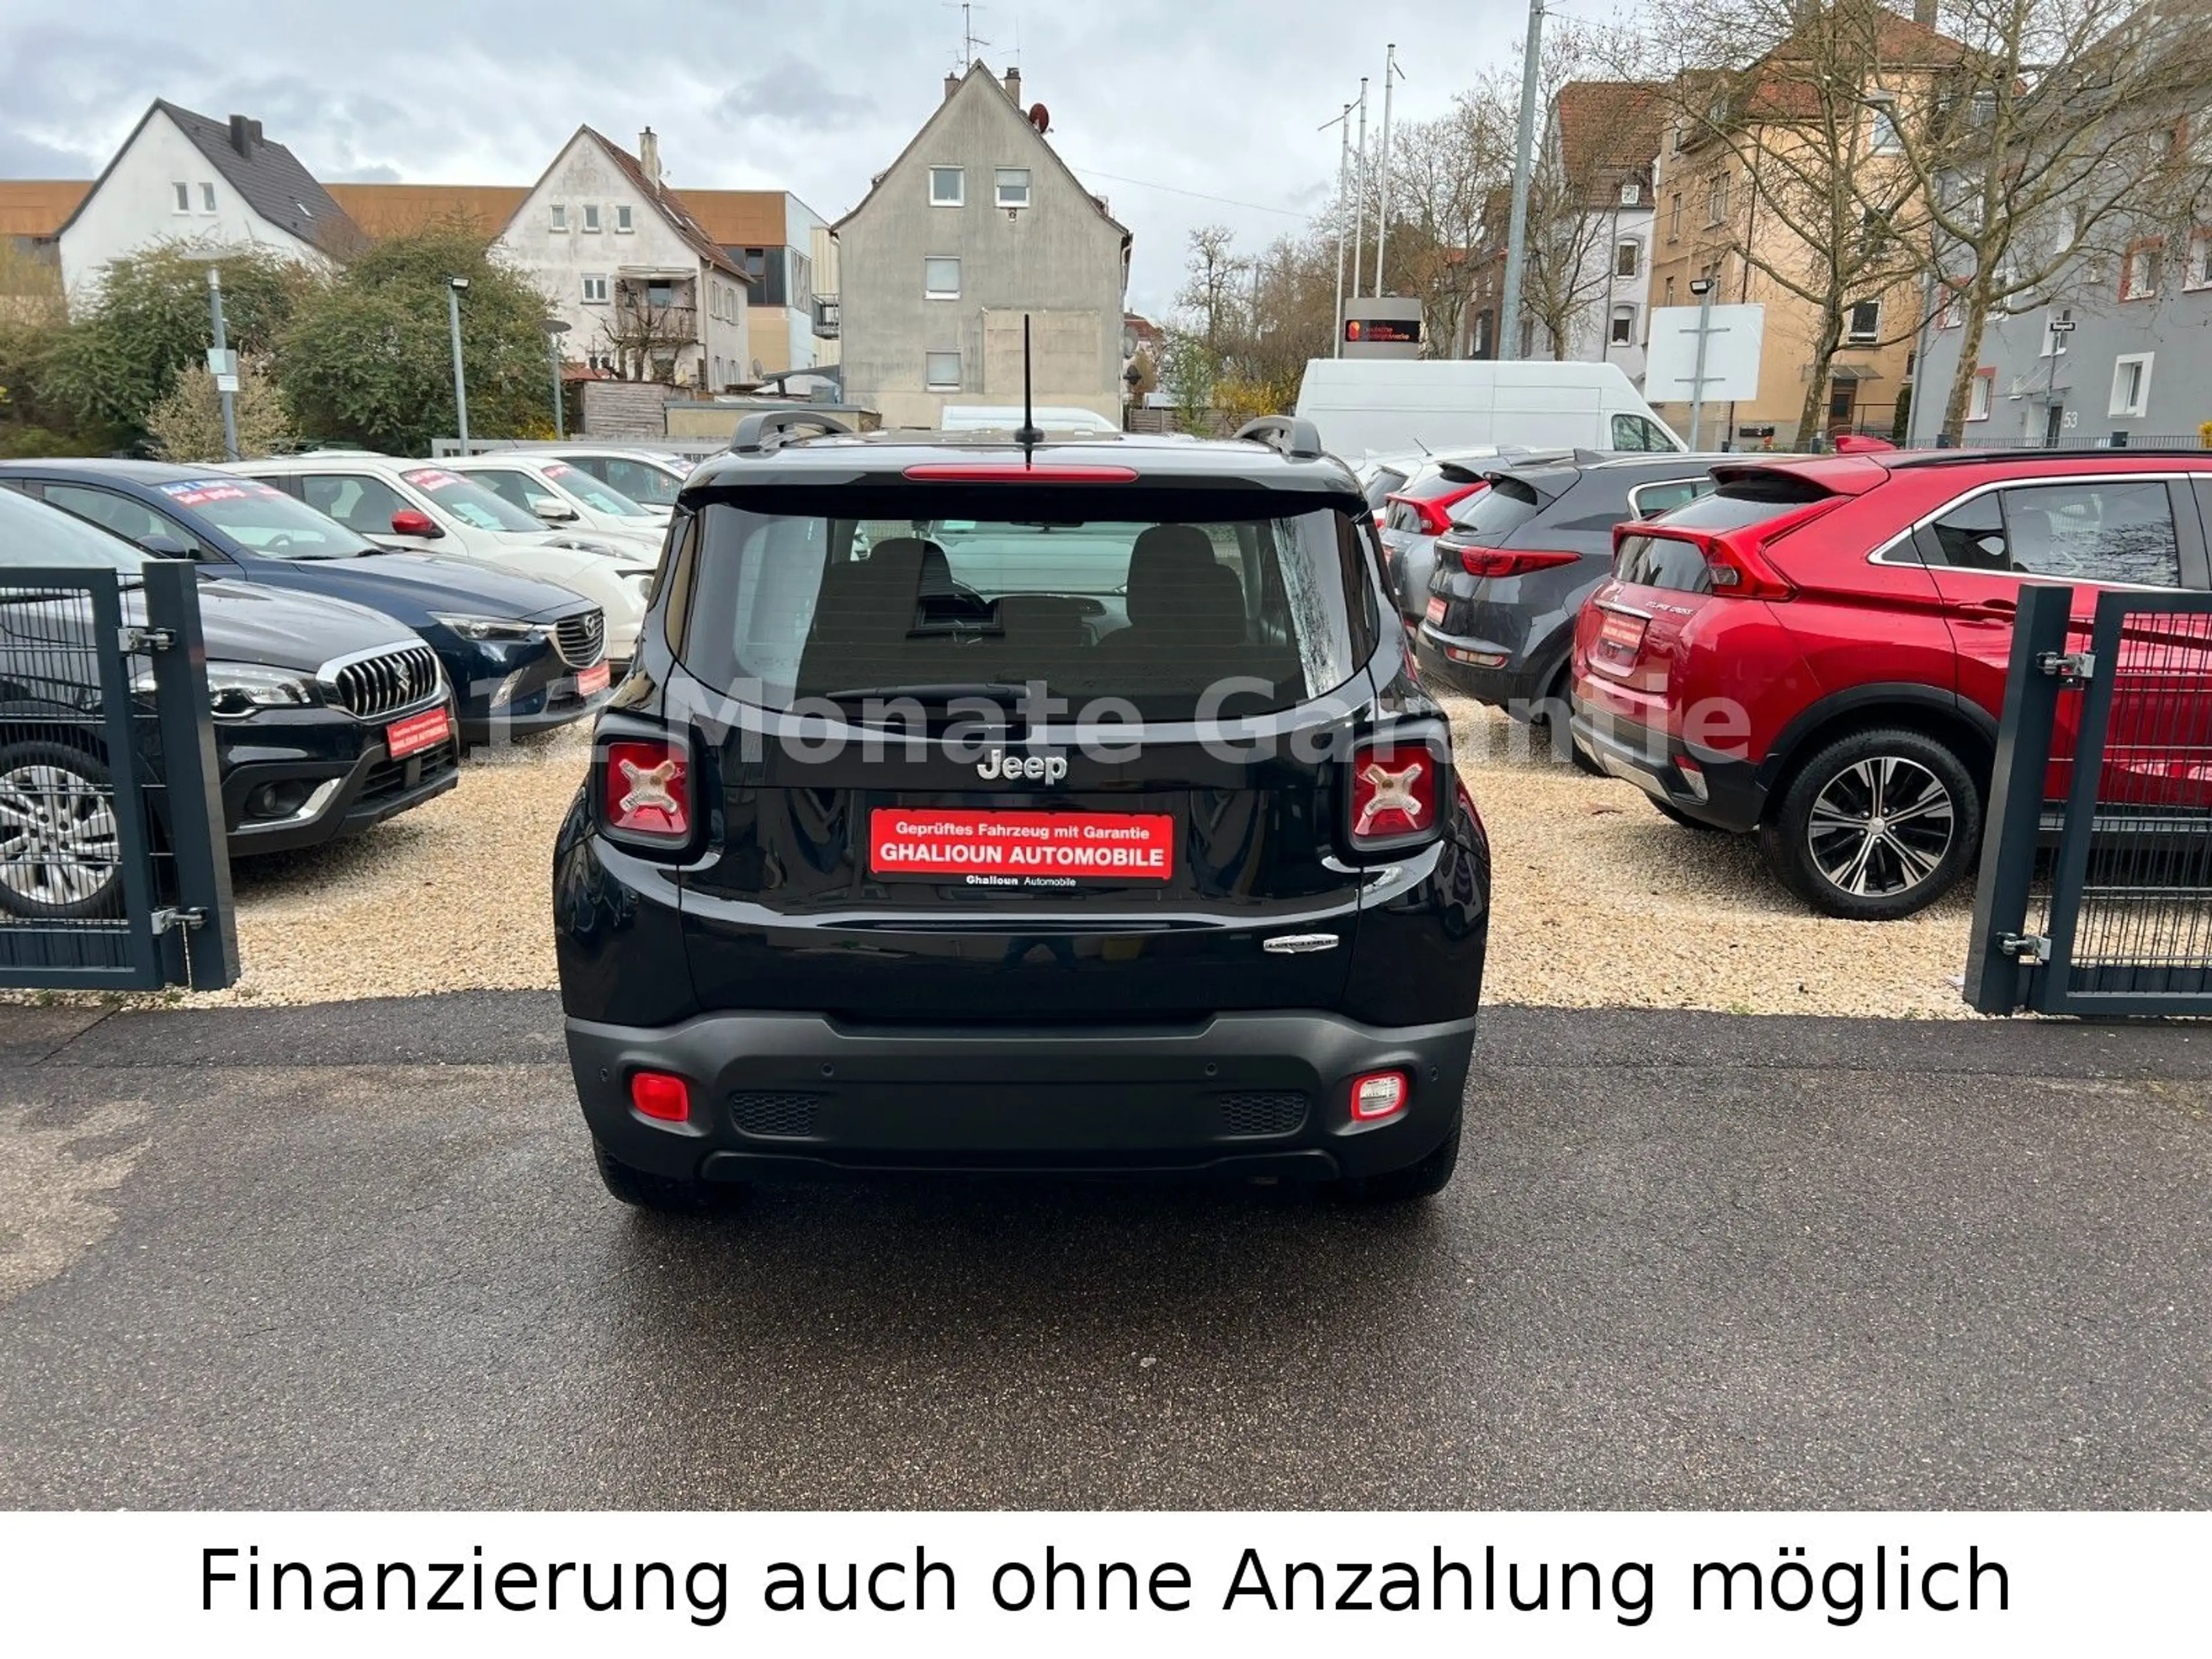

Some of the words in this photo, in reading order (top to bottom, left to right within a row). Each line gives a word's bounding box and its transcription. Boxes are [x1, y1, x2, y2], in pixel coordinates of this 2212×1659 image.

[2064, 411, 2077, 428] 53
[976, 749, 1067, 785] Jeep
[896, 821, 973, 837] Geprüftes
[978, 824, 1049, 839] Fahrzeug
[1055, 826, 1078, 838] mit
[1084, 826, 1150, 839] Garantie
[880, 843, 1002, 863] GHALIOUN
[1009, 847, 1164, 866] AUTOMOBILE
[966, 874, 1018, 885] Ghalioun
[1024, 876, 1076, 887] Automobile
